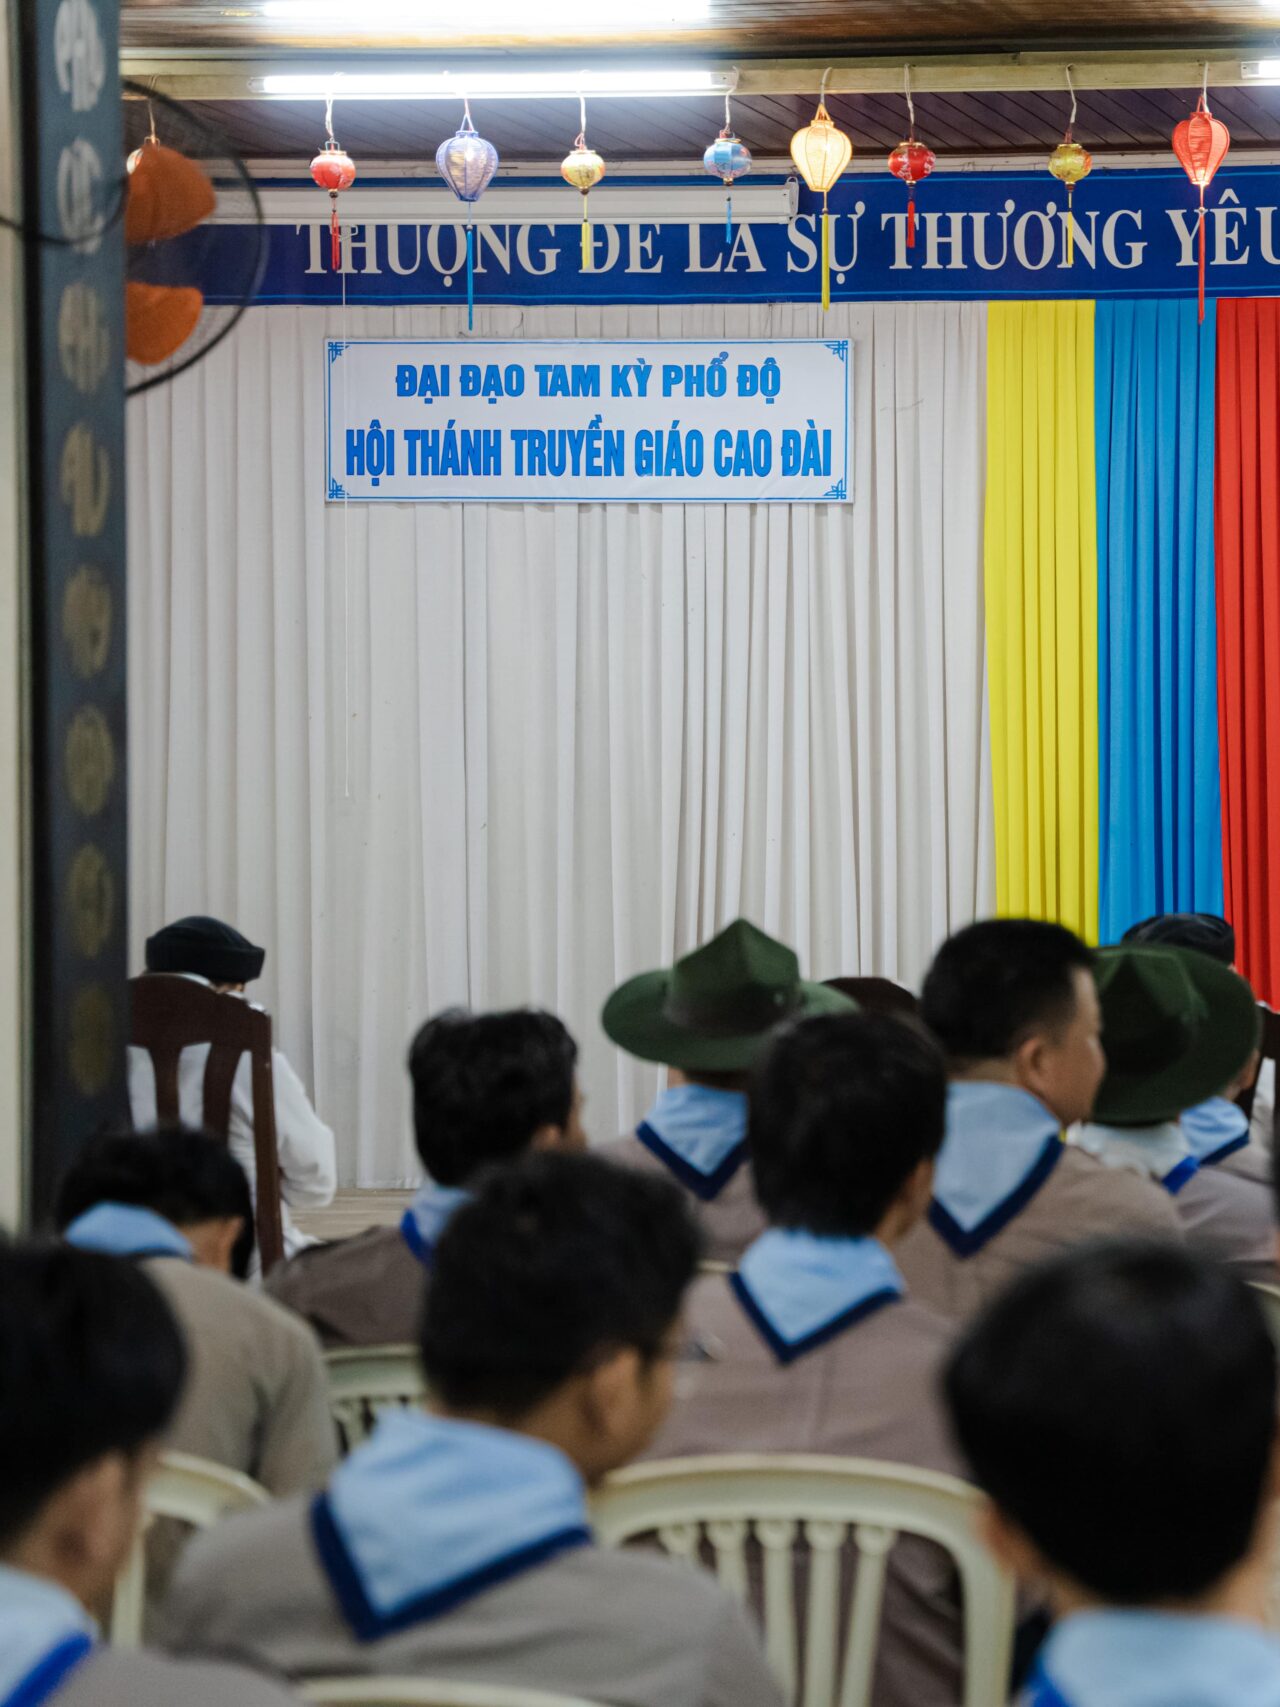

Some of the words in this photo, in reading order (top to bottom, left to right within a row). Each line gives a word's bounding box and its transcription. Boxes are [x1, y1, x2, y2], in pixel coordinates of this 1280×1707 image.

[787, 200, 865, 285] SỰ
[881, 199, 1147, 270] THƯƠNG
[396, 363, 451, 404] ĐẠI
[459, 363, 525, 404] ĐẠO
[534, 363, 600, 397] TAM
[611, 358, 651, 397] KỲ
[662, 351, 729, 397] PHỔ
[736, 357, 781, 404] ĐỘ
[346, 419, 395, 486] HỘI
[404, 419, 502, 476] THÁNH
[510, 414, 625, 476] TRUYỀN
[634, 419, 704, 476] GIÁO
[713, 429, 772, 476] CAO
[780, 419, 832, 476] ĐÀI
